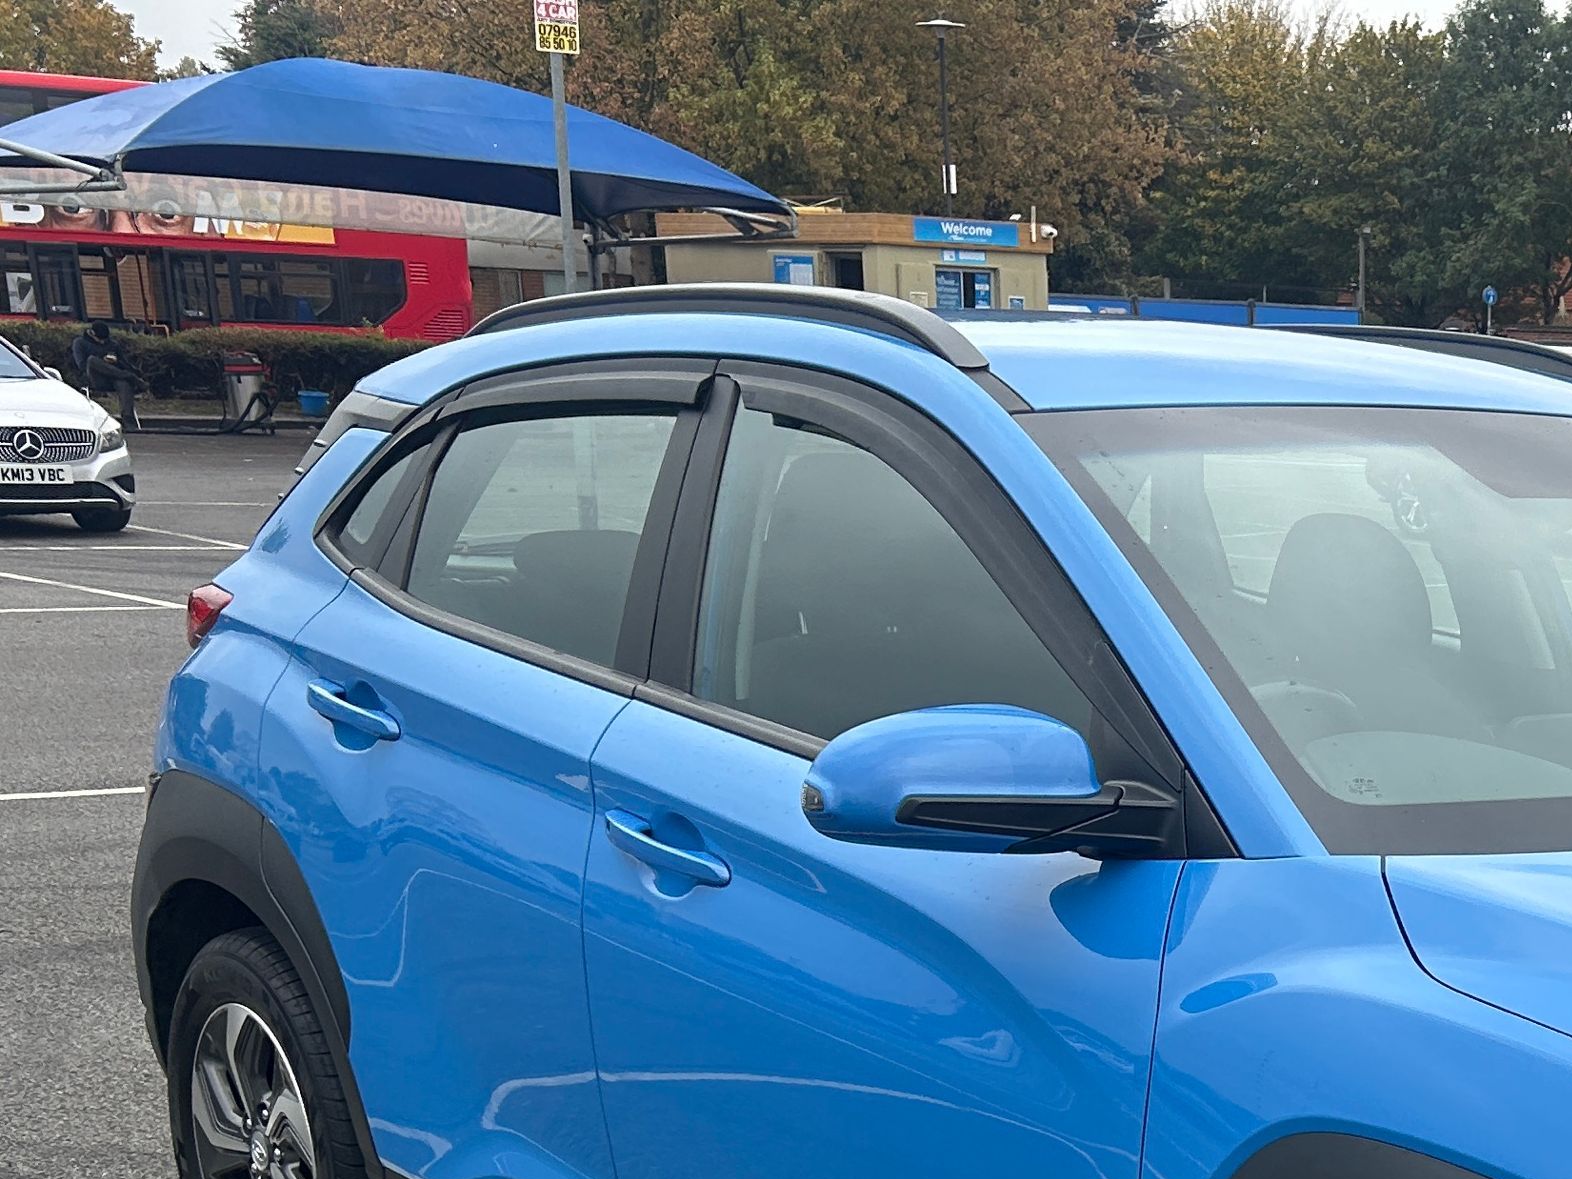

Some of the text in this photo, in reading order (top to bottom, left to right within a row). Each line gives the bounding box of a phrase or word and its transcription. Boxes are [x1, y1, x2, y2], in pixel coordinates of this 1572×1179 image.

[537, 3, 546, 17] 4
[549, 4, 576, 18] CAR
[538, 24, 577, 38] 07946
[539, 36, 577, 51] 85 50 10
[941, 222, 992, 237] Welcome
[1, 468, 65, 481] KM13 VBC
